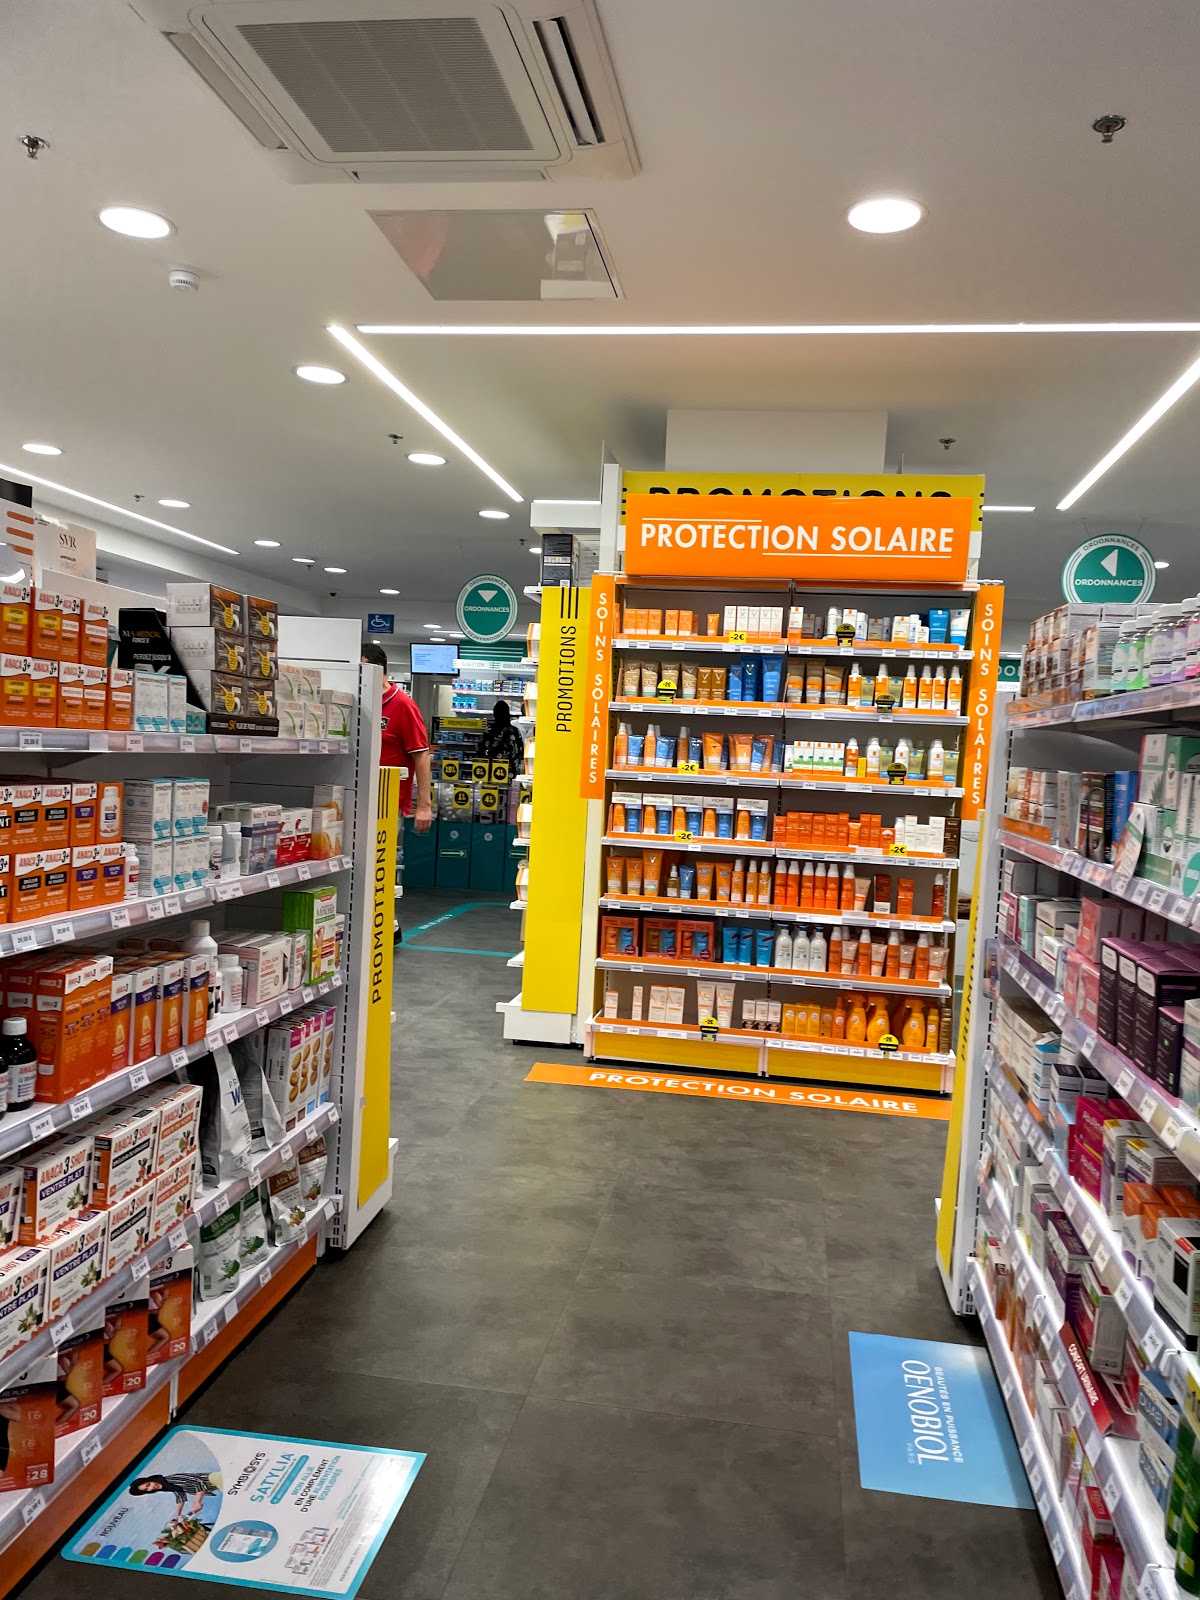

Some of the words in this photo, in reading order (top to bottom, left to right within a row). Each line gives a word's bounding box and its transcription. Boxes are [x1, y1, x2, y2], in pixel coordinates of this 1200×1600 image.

[59, 533, 77, 549] SVR
[641, 523, 819, 551] PROTECTION
[831, 526, 954, 553] SOLAIRE
[1083, 537, 1140, 552] ORDONNANCES
[1075, 578, 1144, 587] ORDONNANCES
[464, 605, 510, 613] ORDONNANCES
[593, 592, 608, 662] SOINS
[731, 633, 744, 641] -2€
[980, 603, 995, 676] SOINS
[556, 625, 577, 733] PROMOTIONS
[588, 673, 604, 785] SOLAIRES
[971, 688, 989, 805] SOLAIRES
[682, 764, 695, 772] -2€
[891, 846, 905, 854] -2€
[372, 829, 387, 1005] PROMOTIONS
[589, 1073, 776, 1097] PROTECTION
[790, 1091, 918, 1112] SOLAIRE
[179, 1103, 185, 1118] 3
[133, 1129, 138, 1145] 3
[64, 1156, 70, 1174] 3
[41, 1179, 67, 1197] VENTRE
[67, 1170, 83, 1184] PLAT
[174, 1167, 179, 1183] 3
[130, 1199, 135, 1216] 3
[78, 1234, 85, 1253] 3
[55, 1257, 81, 1275] VENTRE
[82, 1246, 96, 1260] PLAT
[166, 1257, 172, 1269] 3
[14, 1277, 21, 1297] 3
[18, 1288, 36, 1302] PLAT
[173, 1341, 186, 1352] 20
[126, 1376, 141, 1387] 20
[83, 1409, 97, 1421] 20
[901, 1359, 950, 1466] OENOBIOL
[942, 1401, 952, 1412] EN
[945, 1414, 964, 1464] PUISSANCE
[31, 1470, 48, 1480] 28
[227, 1451, 266, 1496] SYMBIOSYS
[249, 1453, 295, 1503] SATYLIA
[301, 1458, 330, 1497] COMPLÉMENT
[300, 1494, 317, 1513] D'UNE
[99, 1507, 129, 1537] NOUVEAU
